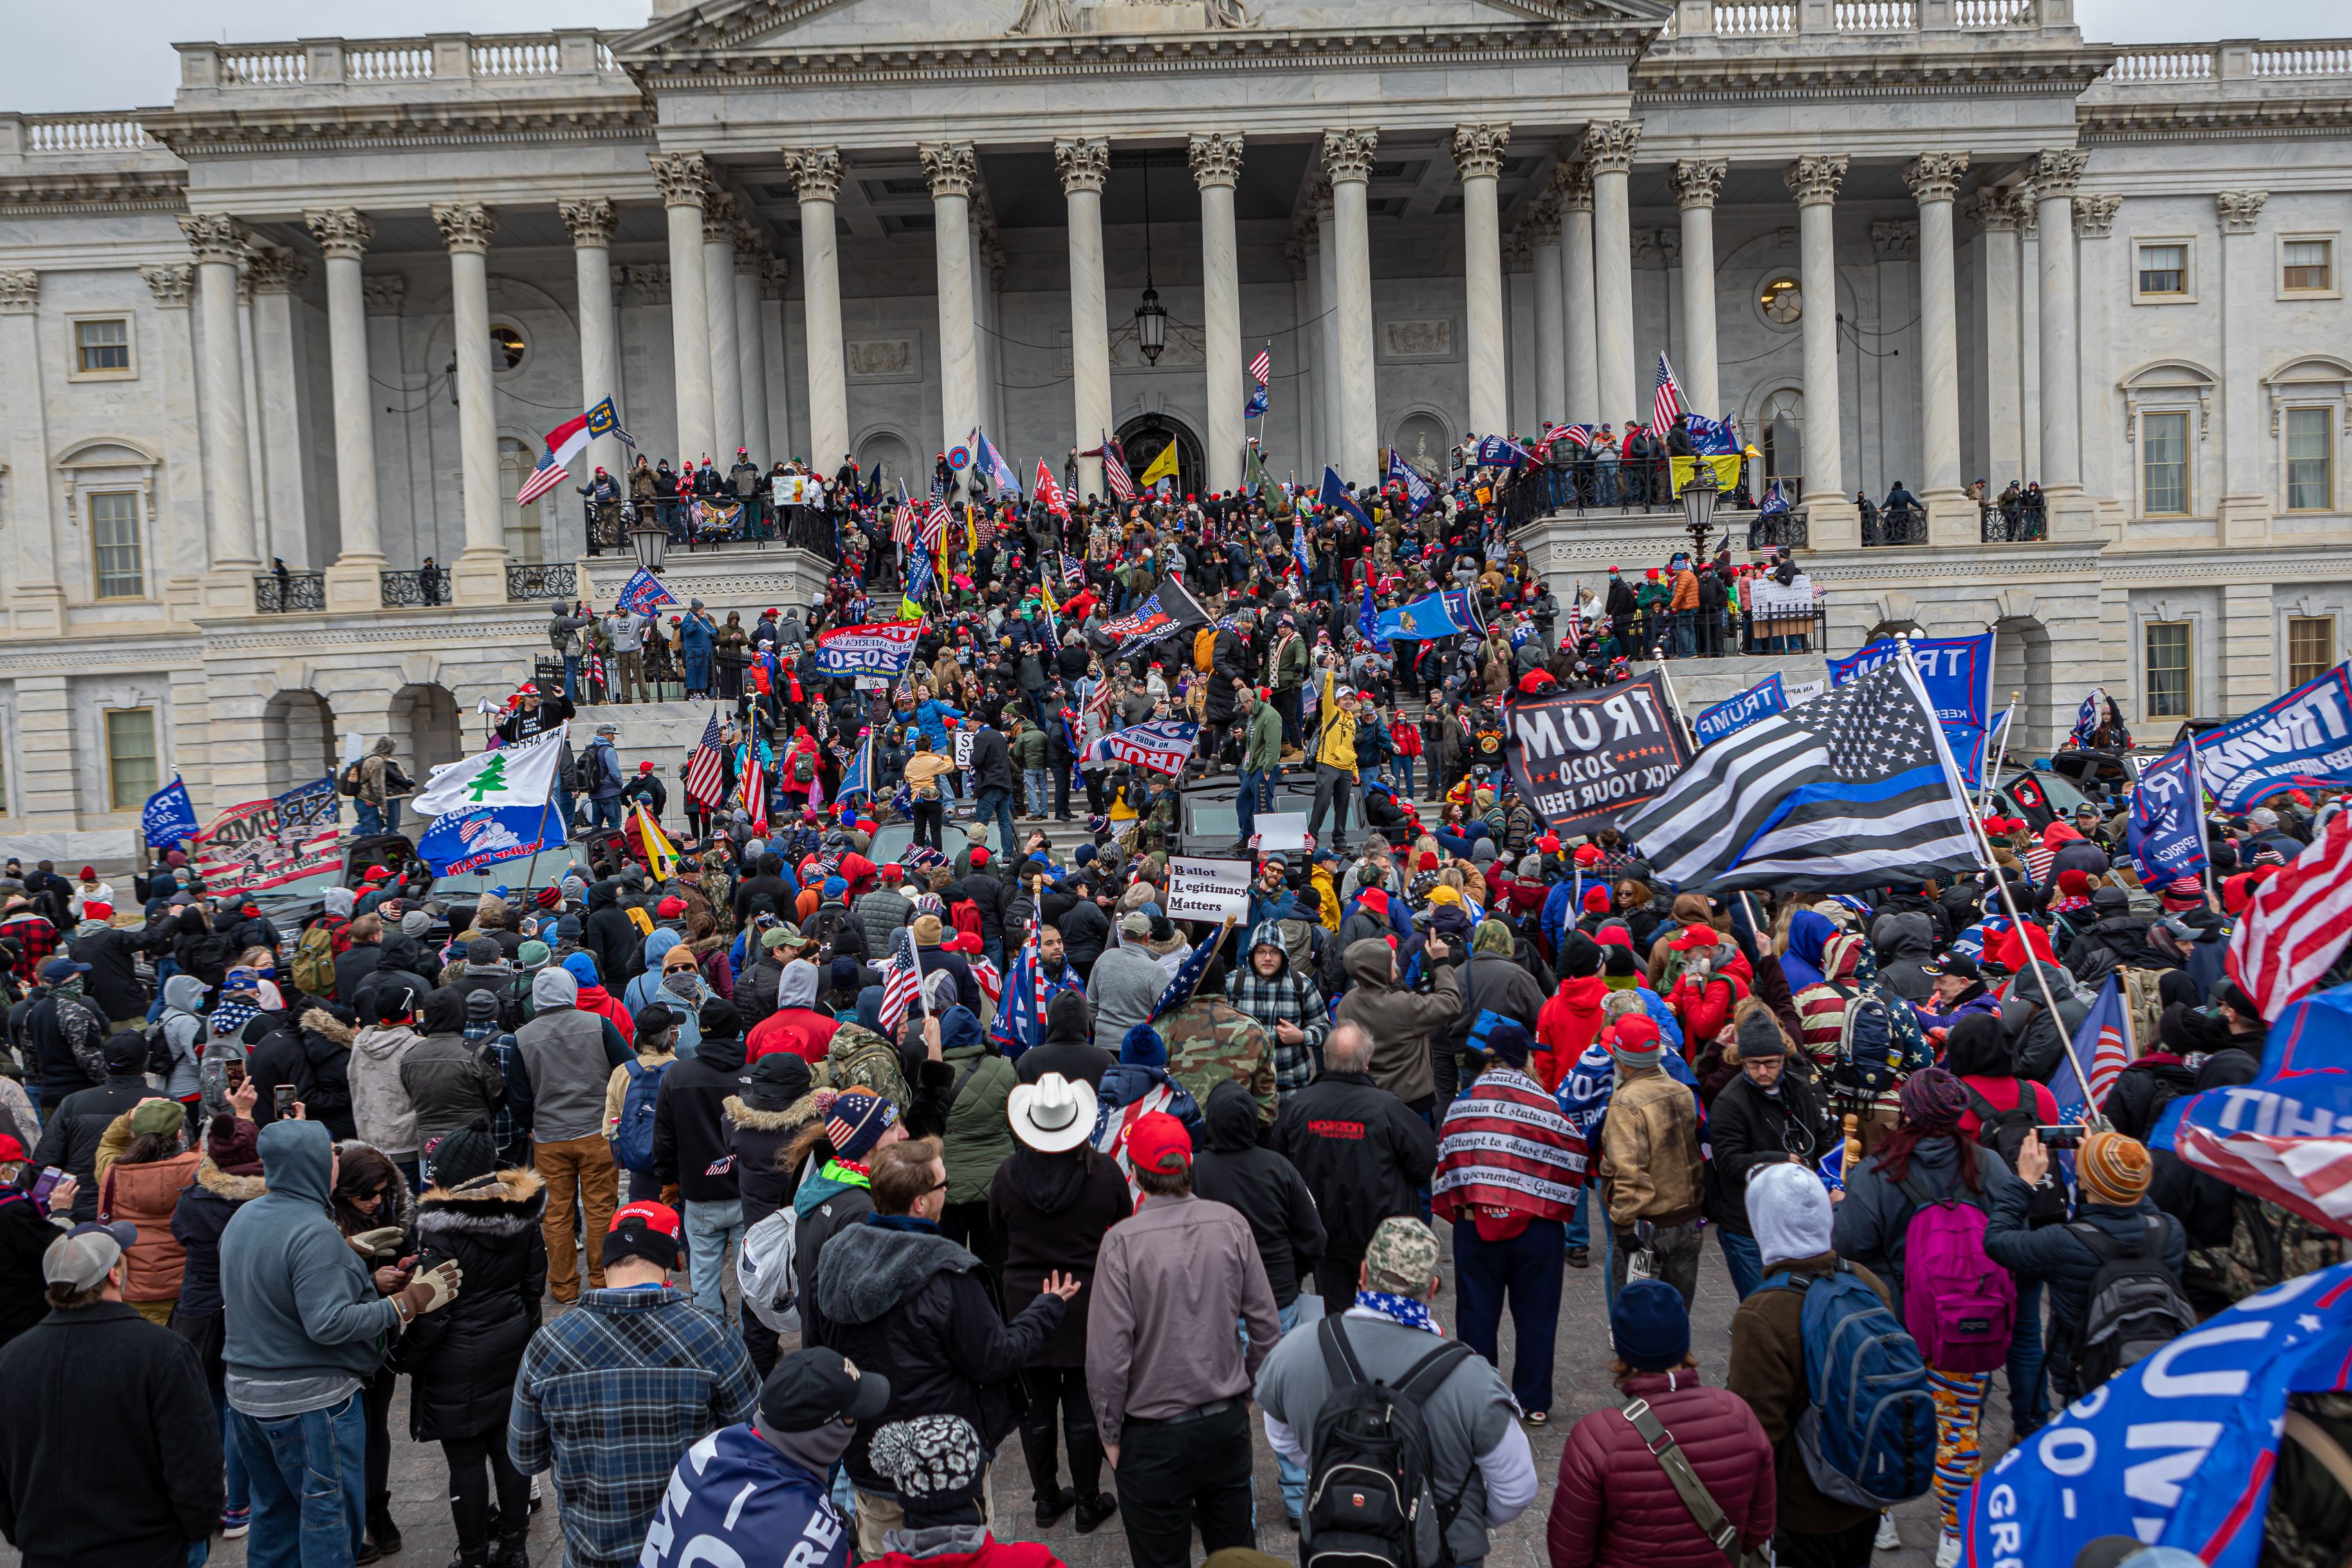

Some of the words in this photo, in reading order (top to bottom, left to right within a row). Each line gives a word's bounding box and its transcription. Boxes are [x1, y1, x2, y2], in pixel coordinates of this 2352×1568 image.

[869, 679, 881, 690] PA
[1134, 734, 1156, 748] MORE
[1174, 865, 1216, 876] Ballot
[1174, 880, 1248, 897] Legitimacy
[1170, 897, 1222, 911] Matters
[1509, 1107, 1547, 1124] status
[1551, 1116, 1564, 1132] of
[1307, 1120, 1365, 1134] HORIZON
[1489, 1137, 1503, 1147] to
[1506, 1139, 1541, 1156] abuse
[1542, 1146, 1572, 1167] them,
[1534, 1182, 1568, 1199] George
